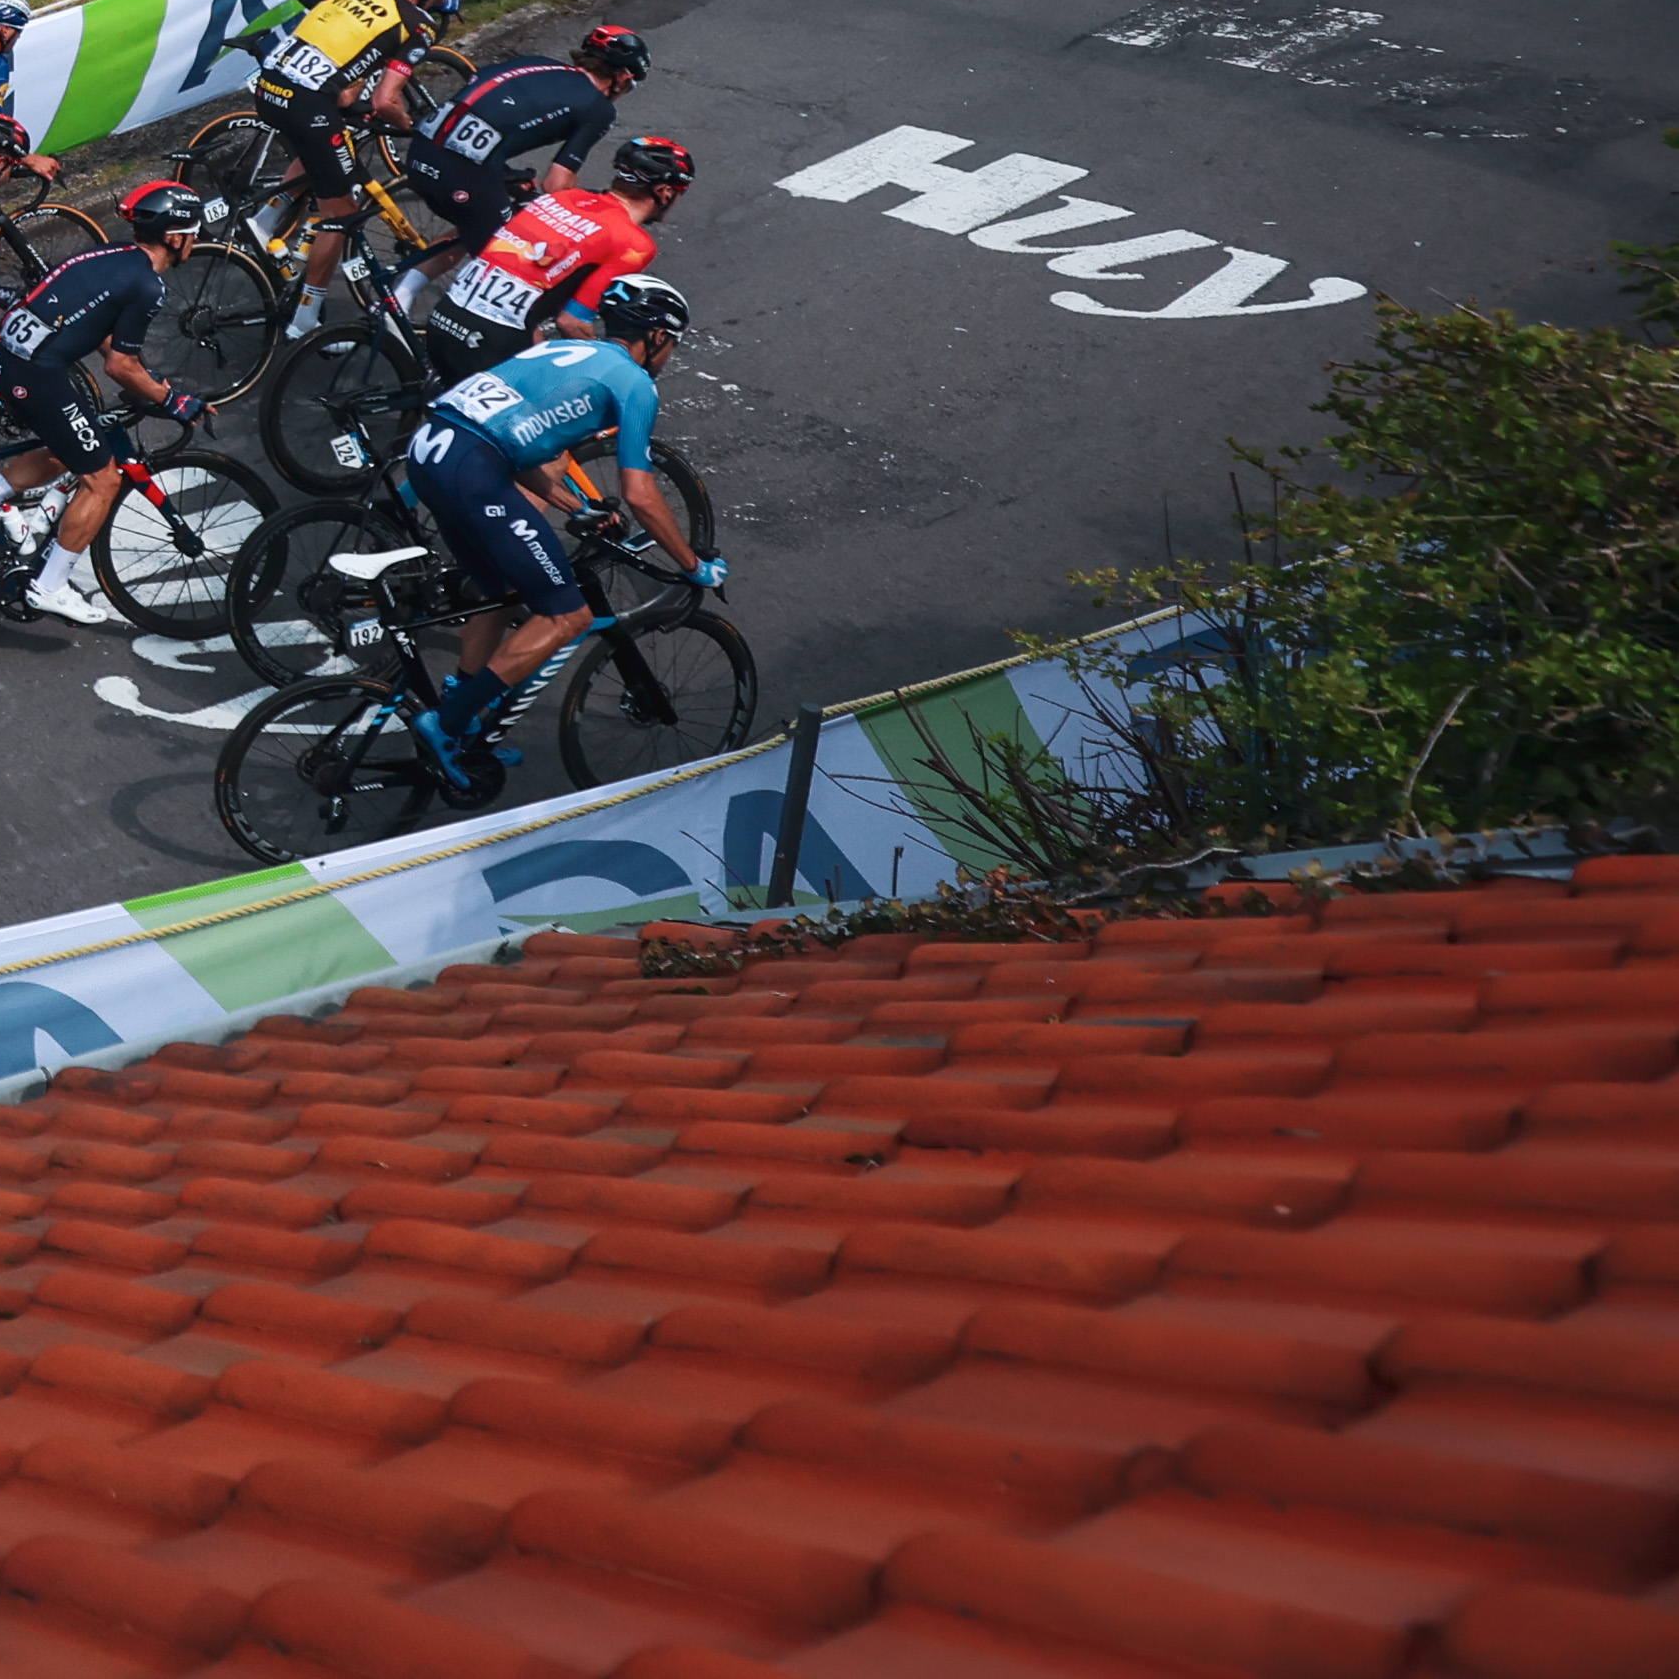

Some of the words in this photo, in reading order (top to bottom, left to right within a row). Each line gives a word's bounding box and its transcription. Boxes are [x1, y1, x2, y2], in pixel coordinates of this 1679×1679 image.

[290, 44, 333, 86] 182
[343, 47, 383, 83] HEMA
[455, 119, 495, 151] 66
[205, 203, 228, 221] 182
[774, 124, 1368, 320] Huy
[484, 273, 530, 316] 124
[6, 312, 41, 344] 65
[459, 380, 512, 412] 192
[61, 402, 101, 452] INEOS
[512, 393, 594, 447] movistar
[527, 536, 567, 587] movistar
[352, 624, 382, 646] 192
